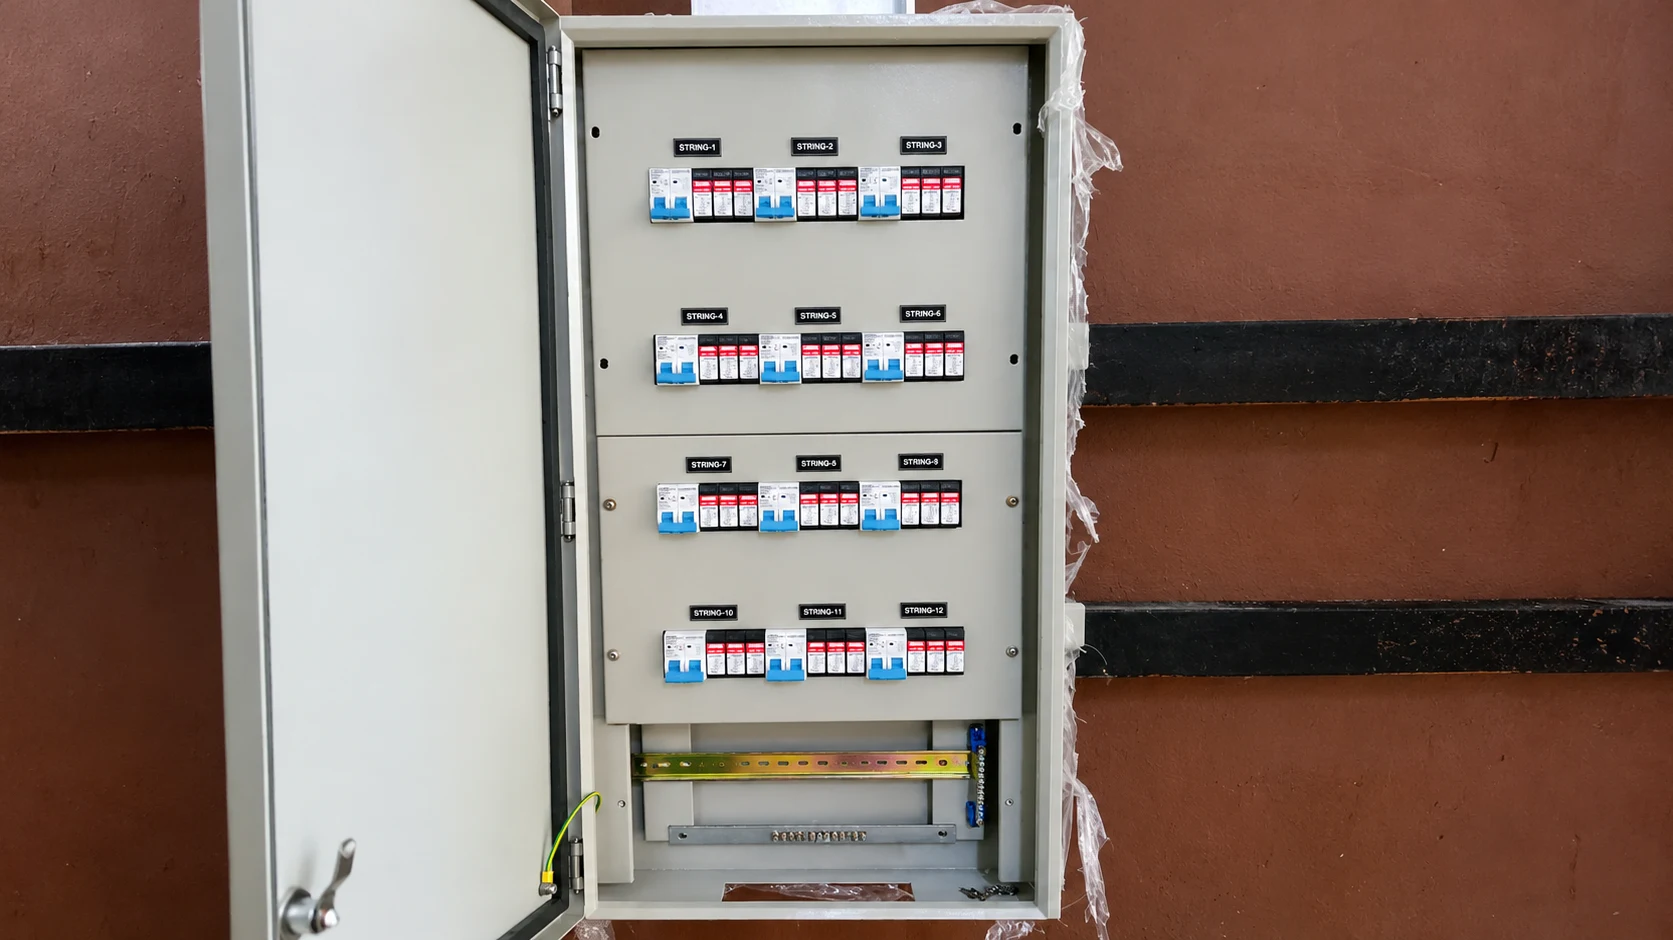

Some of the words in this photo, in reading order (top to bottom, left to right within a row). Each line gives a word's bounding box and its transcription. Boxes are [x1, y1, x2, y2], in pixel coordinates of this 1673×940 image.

[678, 144, 716, 152] STRING-1
[796, 143, 834, 151] STRING-2
[905, 141, 943, 149] STRING-3
[686, 312, 724, 320] STRING-4
[905, 310, 942, 318] STRING-6
[691, 461, 727, 469] STRING-7
[693, 609, 734, 617] STRING-10
[803, 608, 843, 616] STRING-11
[904, 606, 944, 614] STRING-12
